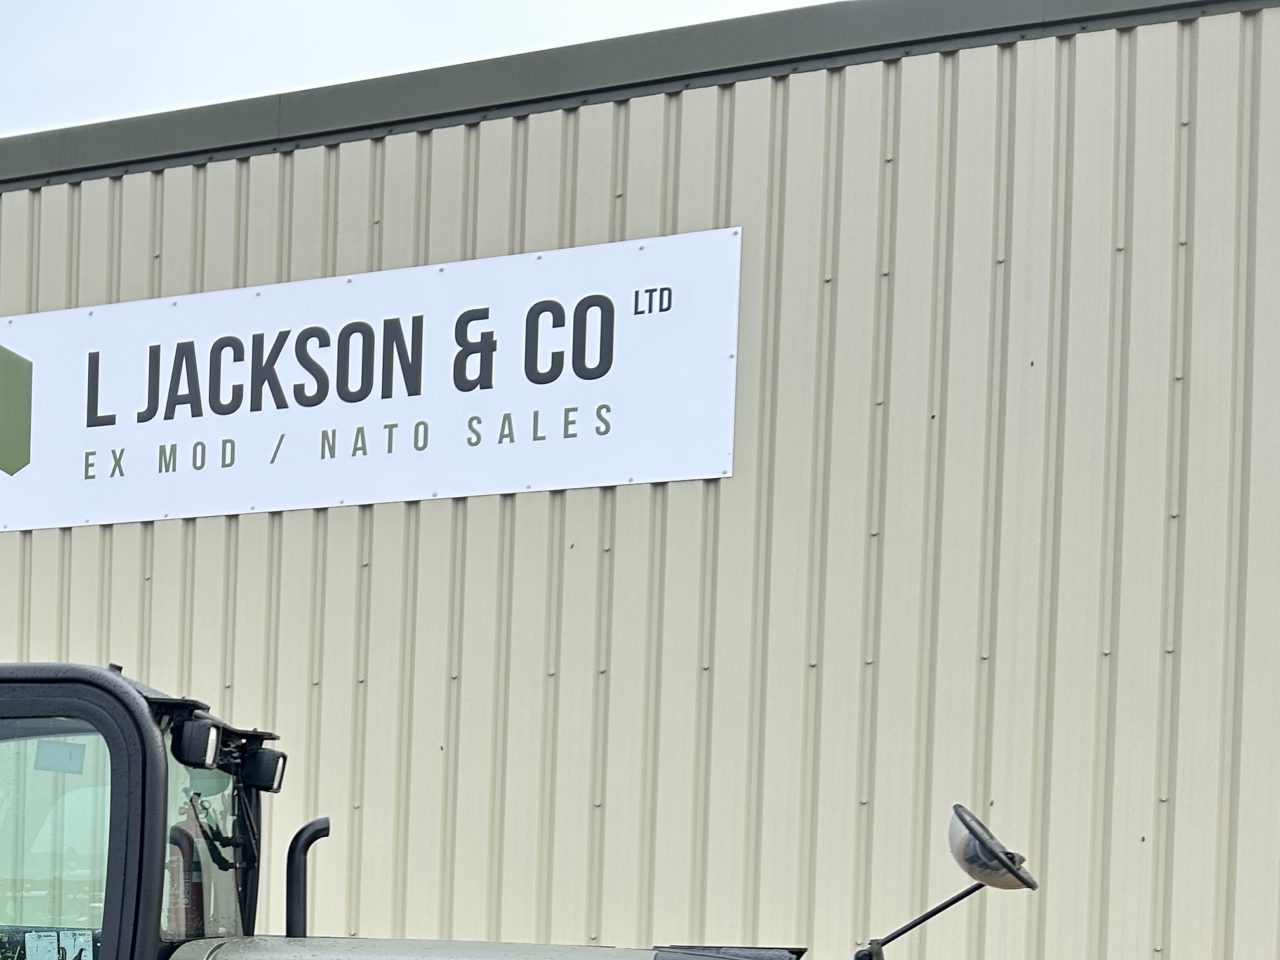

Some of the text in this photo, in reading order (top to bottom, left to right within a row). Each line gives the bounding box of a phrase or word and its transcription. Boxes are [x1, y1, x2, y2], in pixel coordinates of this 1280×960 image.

[86, 286, 673, 428] L JACKSON & CO LTD
[84, 403, 613, 480] EX MOD / NATO SALES
